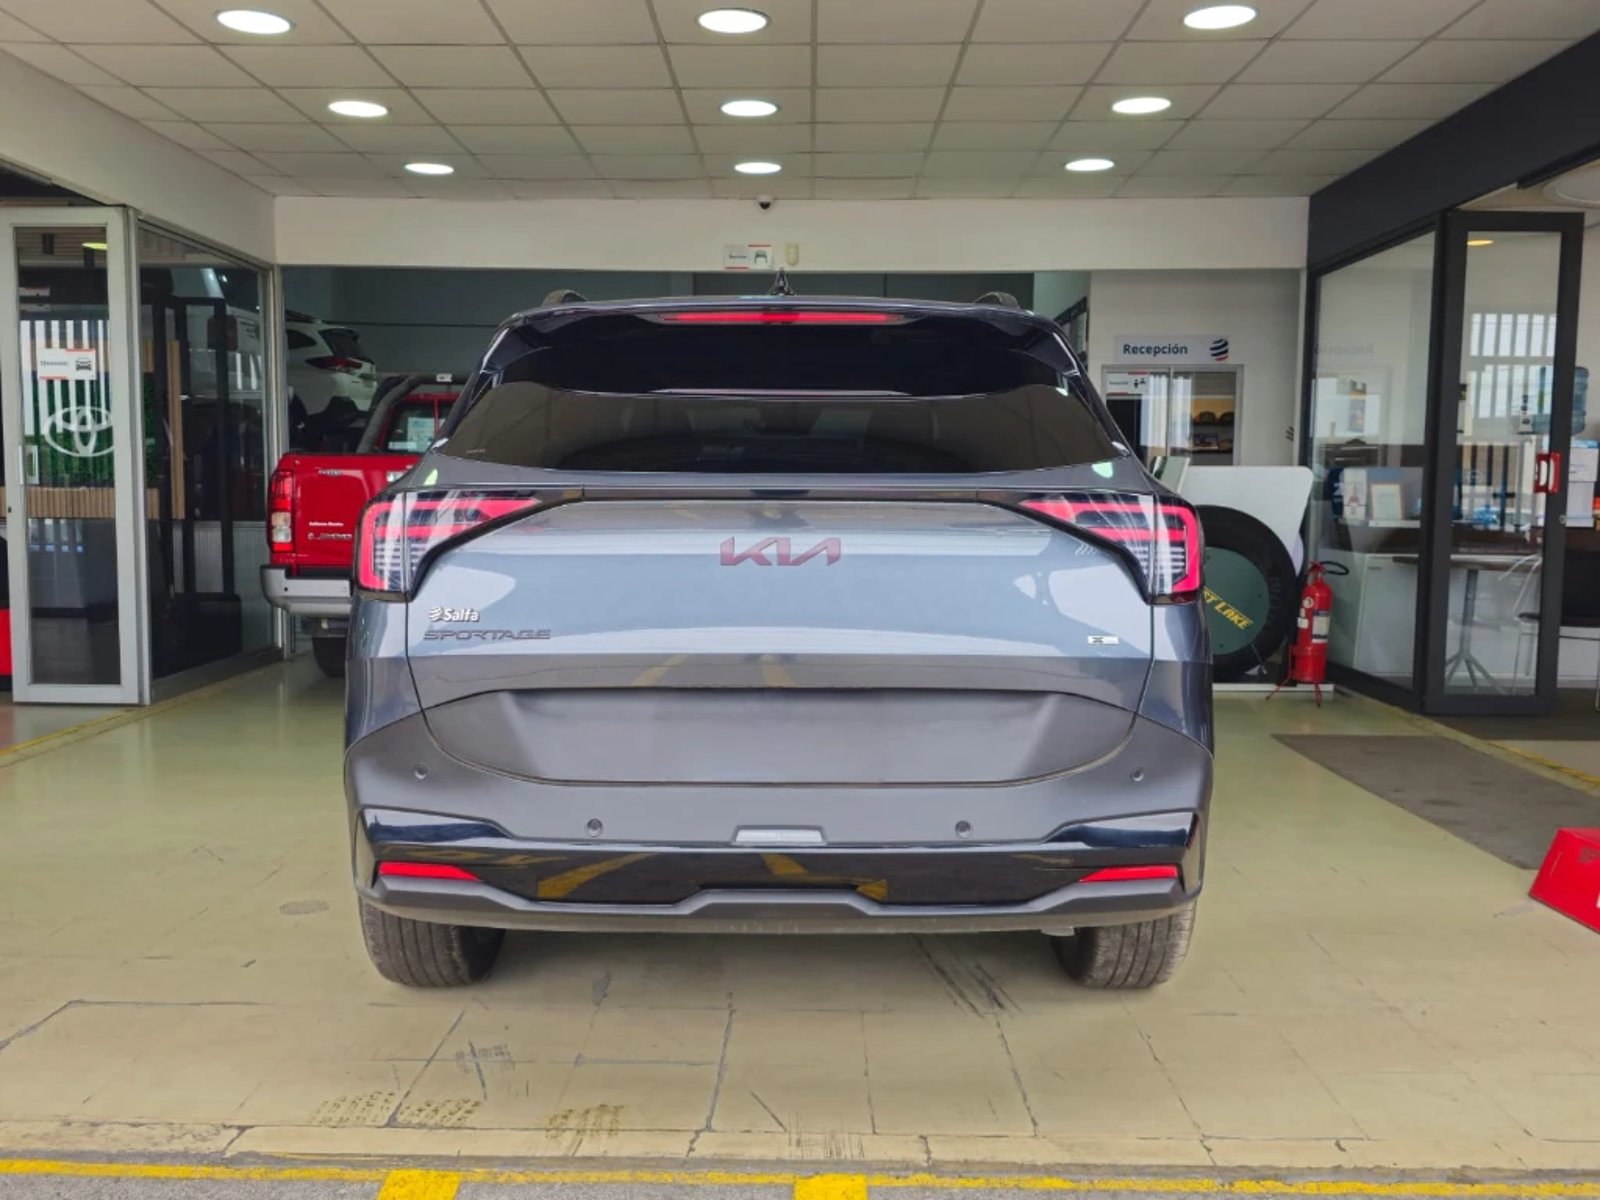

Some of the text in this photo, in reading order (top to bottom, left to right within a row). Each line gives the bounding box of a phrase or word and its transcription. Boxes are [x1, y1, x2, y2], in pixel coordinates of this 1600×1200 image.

[1122, 343, 1188, 357] Recepción
[720, 536, 841, 566] KIA
[443, 608, 479, 622] Salfa
[423, 629, 551, 641] SPORTAGE
